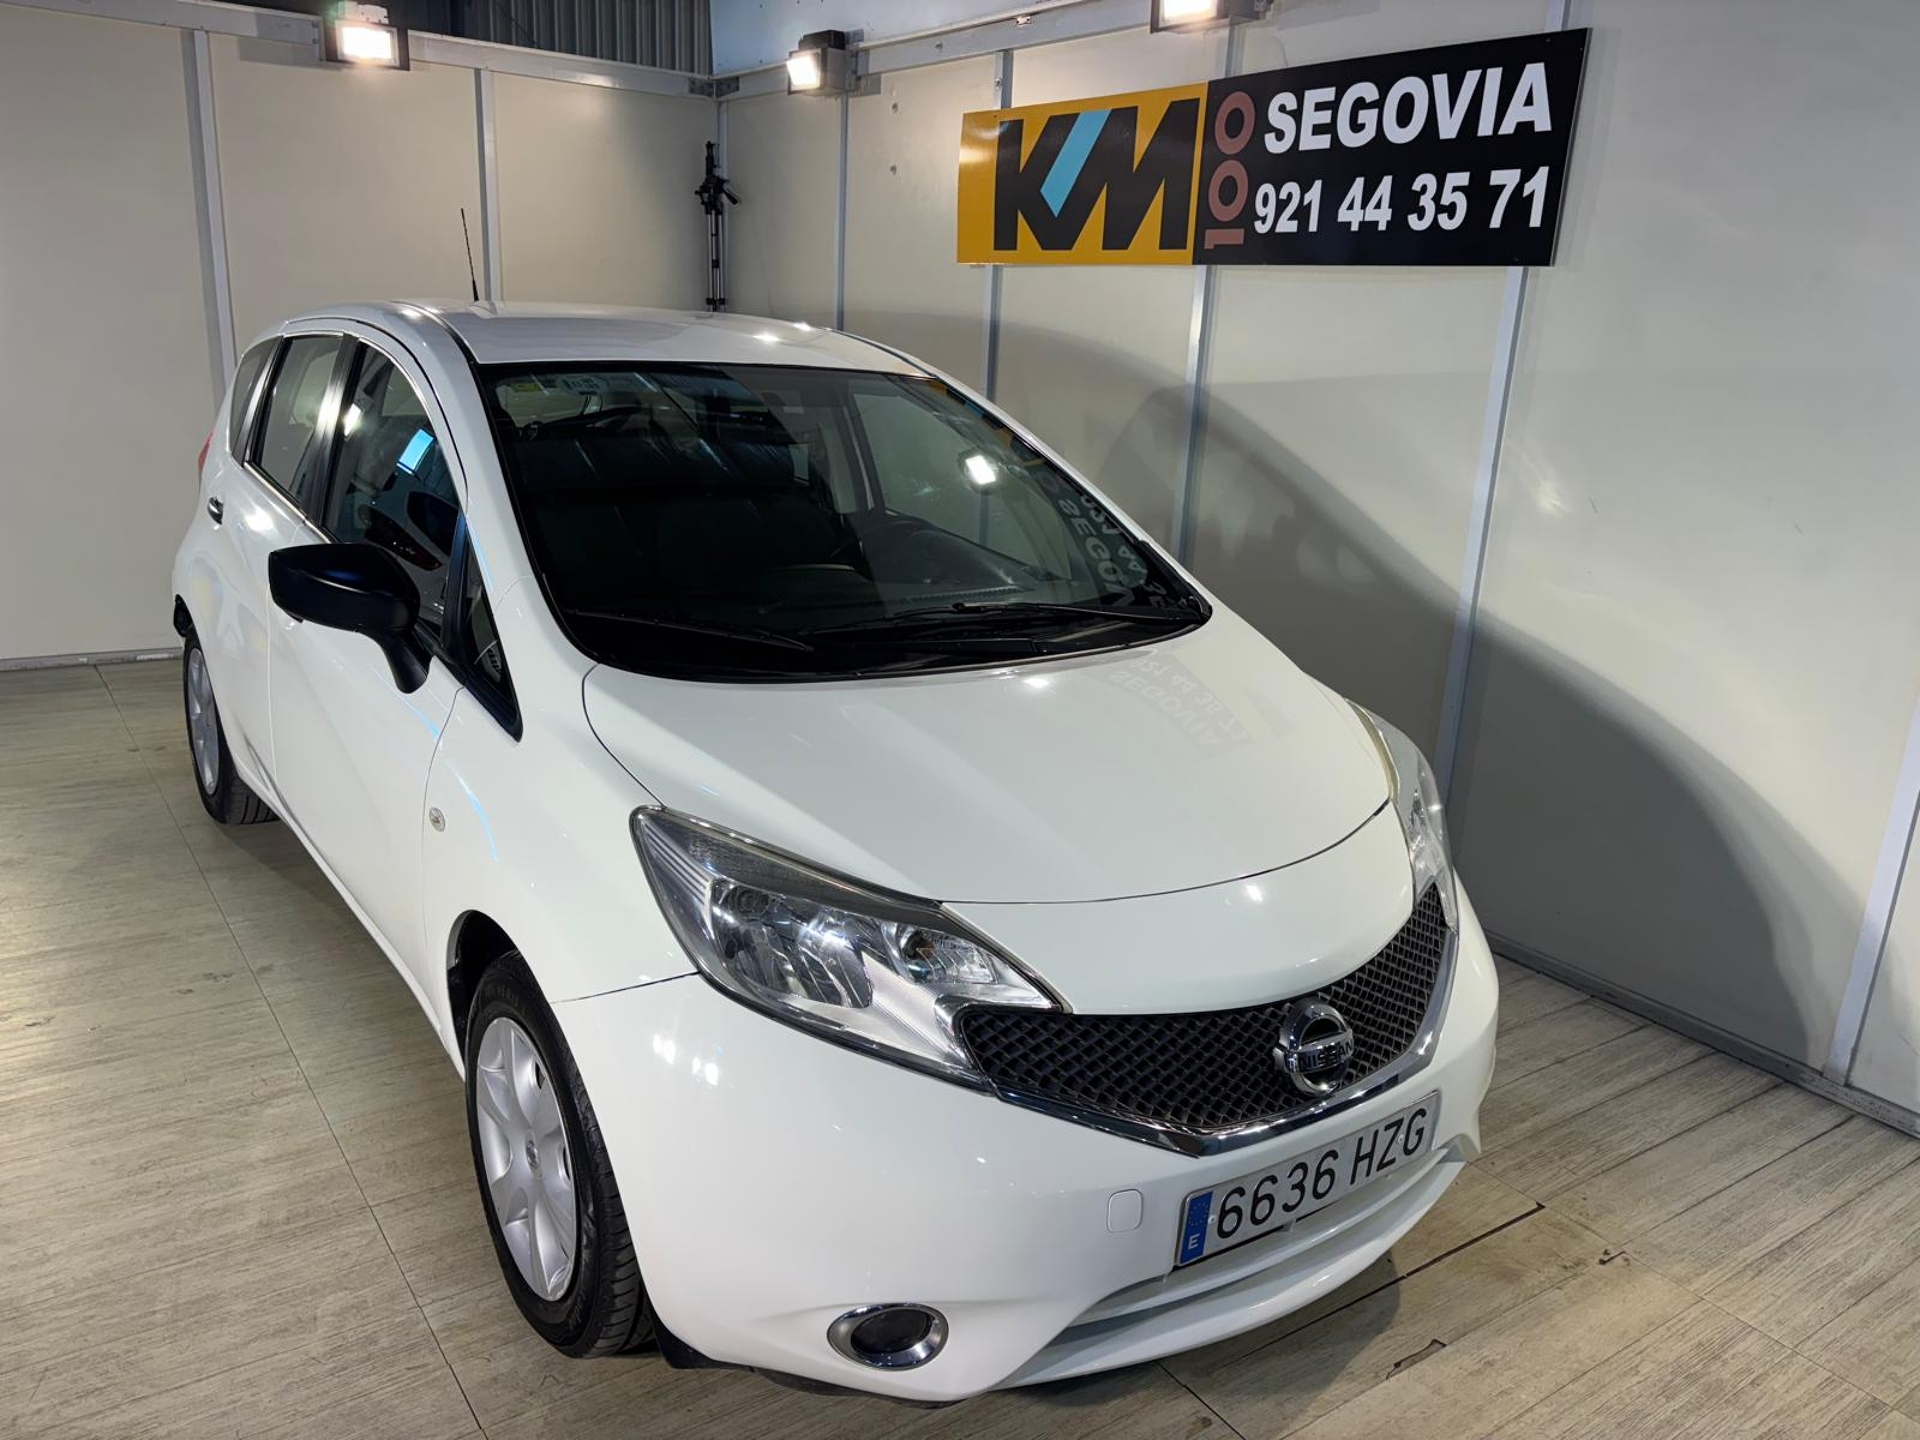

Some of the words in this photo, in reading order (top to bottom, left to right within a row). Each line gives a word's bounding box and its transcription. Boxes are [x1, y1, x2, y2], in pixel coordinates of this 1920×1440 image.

[994, 97, 1200, 250] KM
[1204, 91, 1255, 249] 100
[1264, 62, 1552, 154] SEGOVIA
[1254, 179, 1322, 234] 921
[1337, 175, 1393, 231] 44
[1407, 171, 1470, 231] 35
[1489, 166, 1549, 229] 71
[1188, 1233, 1199, 1249] E
[1217, 1149, 1339, 1239] 6636
[1350, 1108, 1428, 1185] HZG
